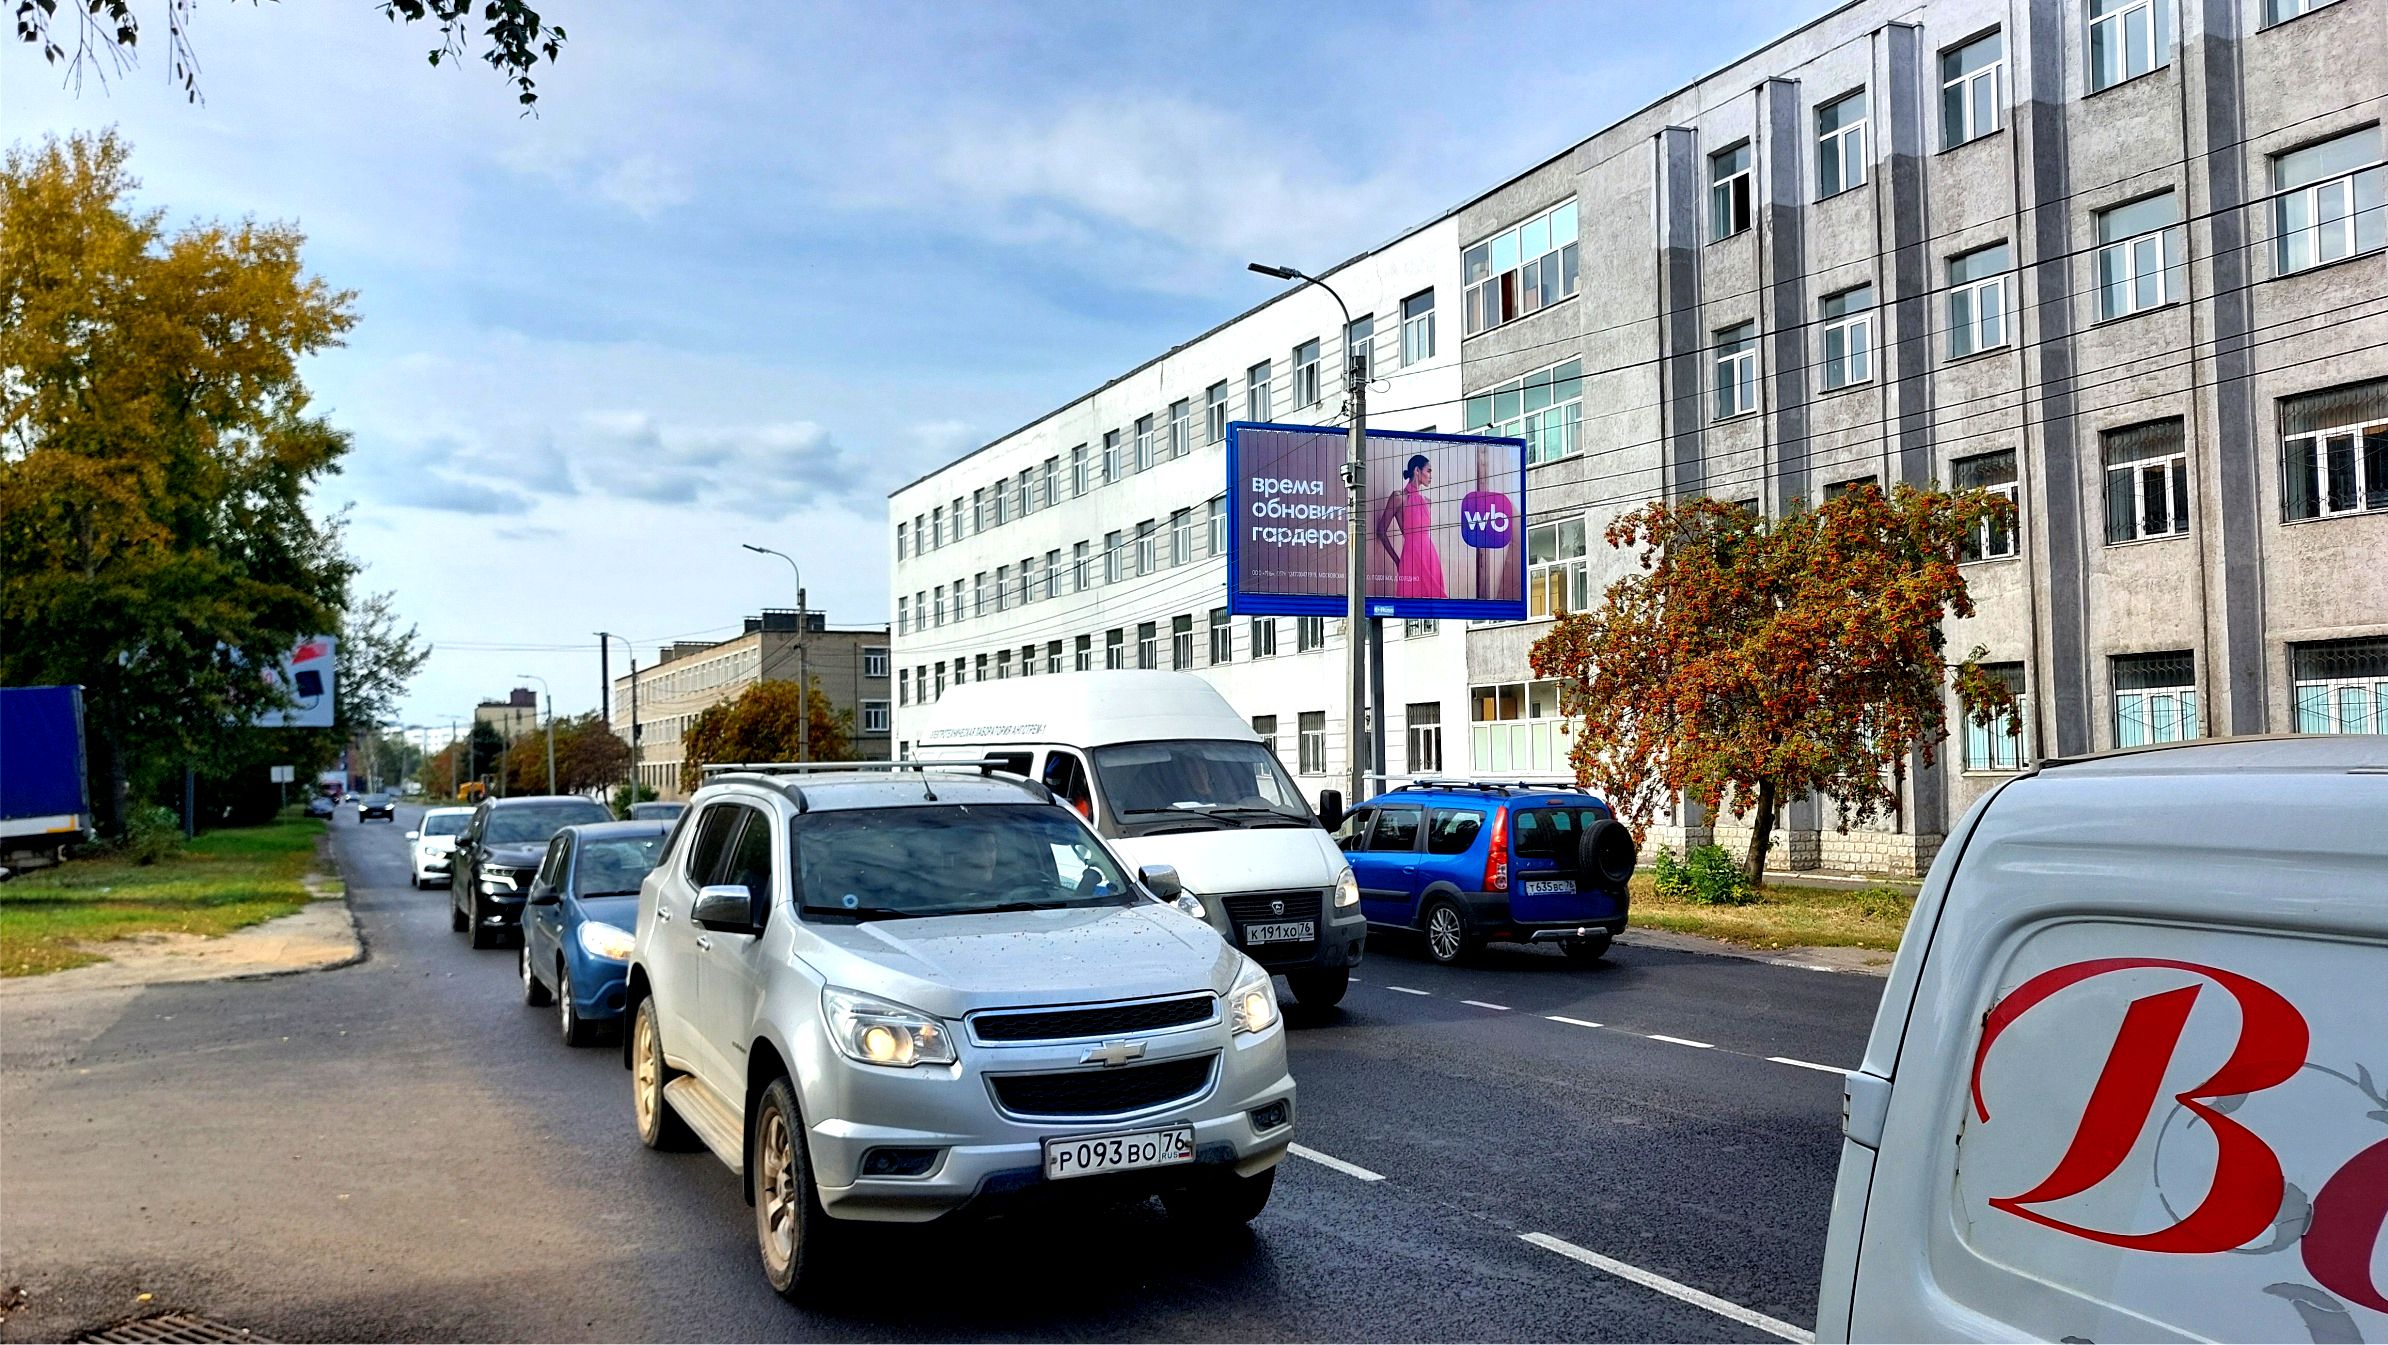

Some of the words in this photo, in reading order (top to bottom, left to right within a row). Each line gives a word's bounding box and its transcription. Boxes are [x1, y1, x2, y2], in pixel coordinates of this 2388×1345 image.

[1252, 477, 1324, 498] время
[1252, 497, 1347, 520] обновит
[1464, 503, 1509, 532] wb
[1252, 526, 1347, 549] гардеро
[1251, 925, 1297, 940] К191ХО
[1299, 922, 1311, 935] 76
[1060, 1140, 1157, 1171] Р093ВО
[1163, 1131, 1185, 1152] 76
[1161, 1152, 1178, 1160] RUS
